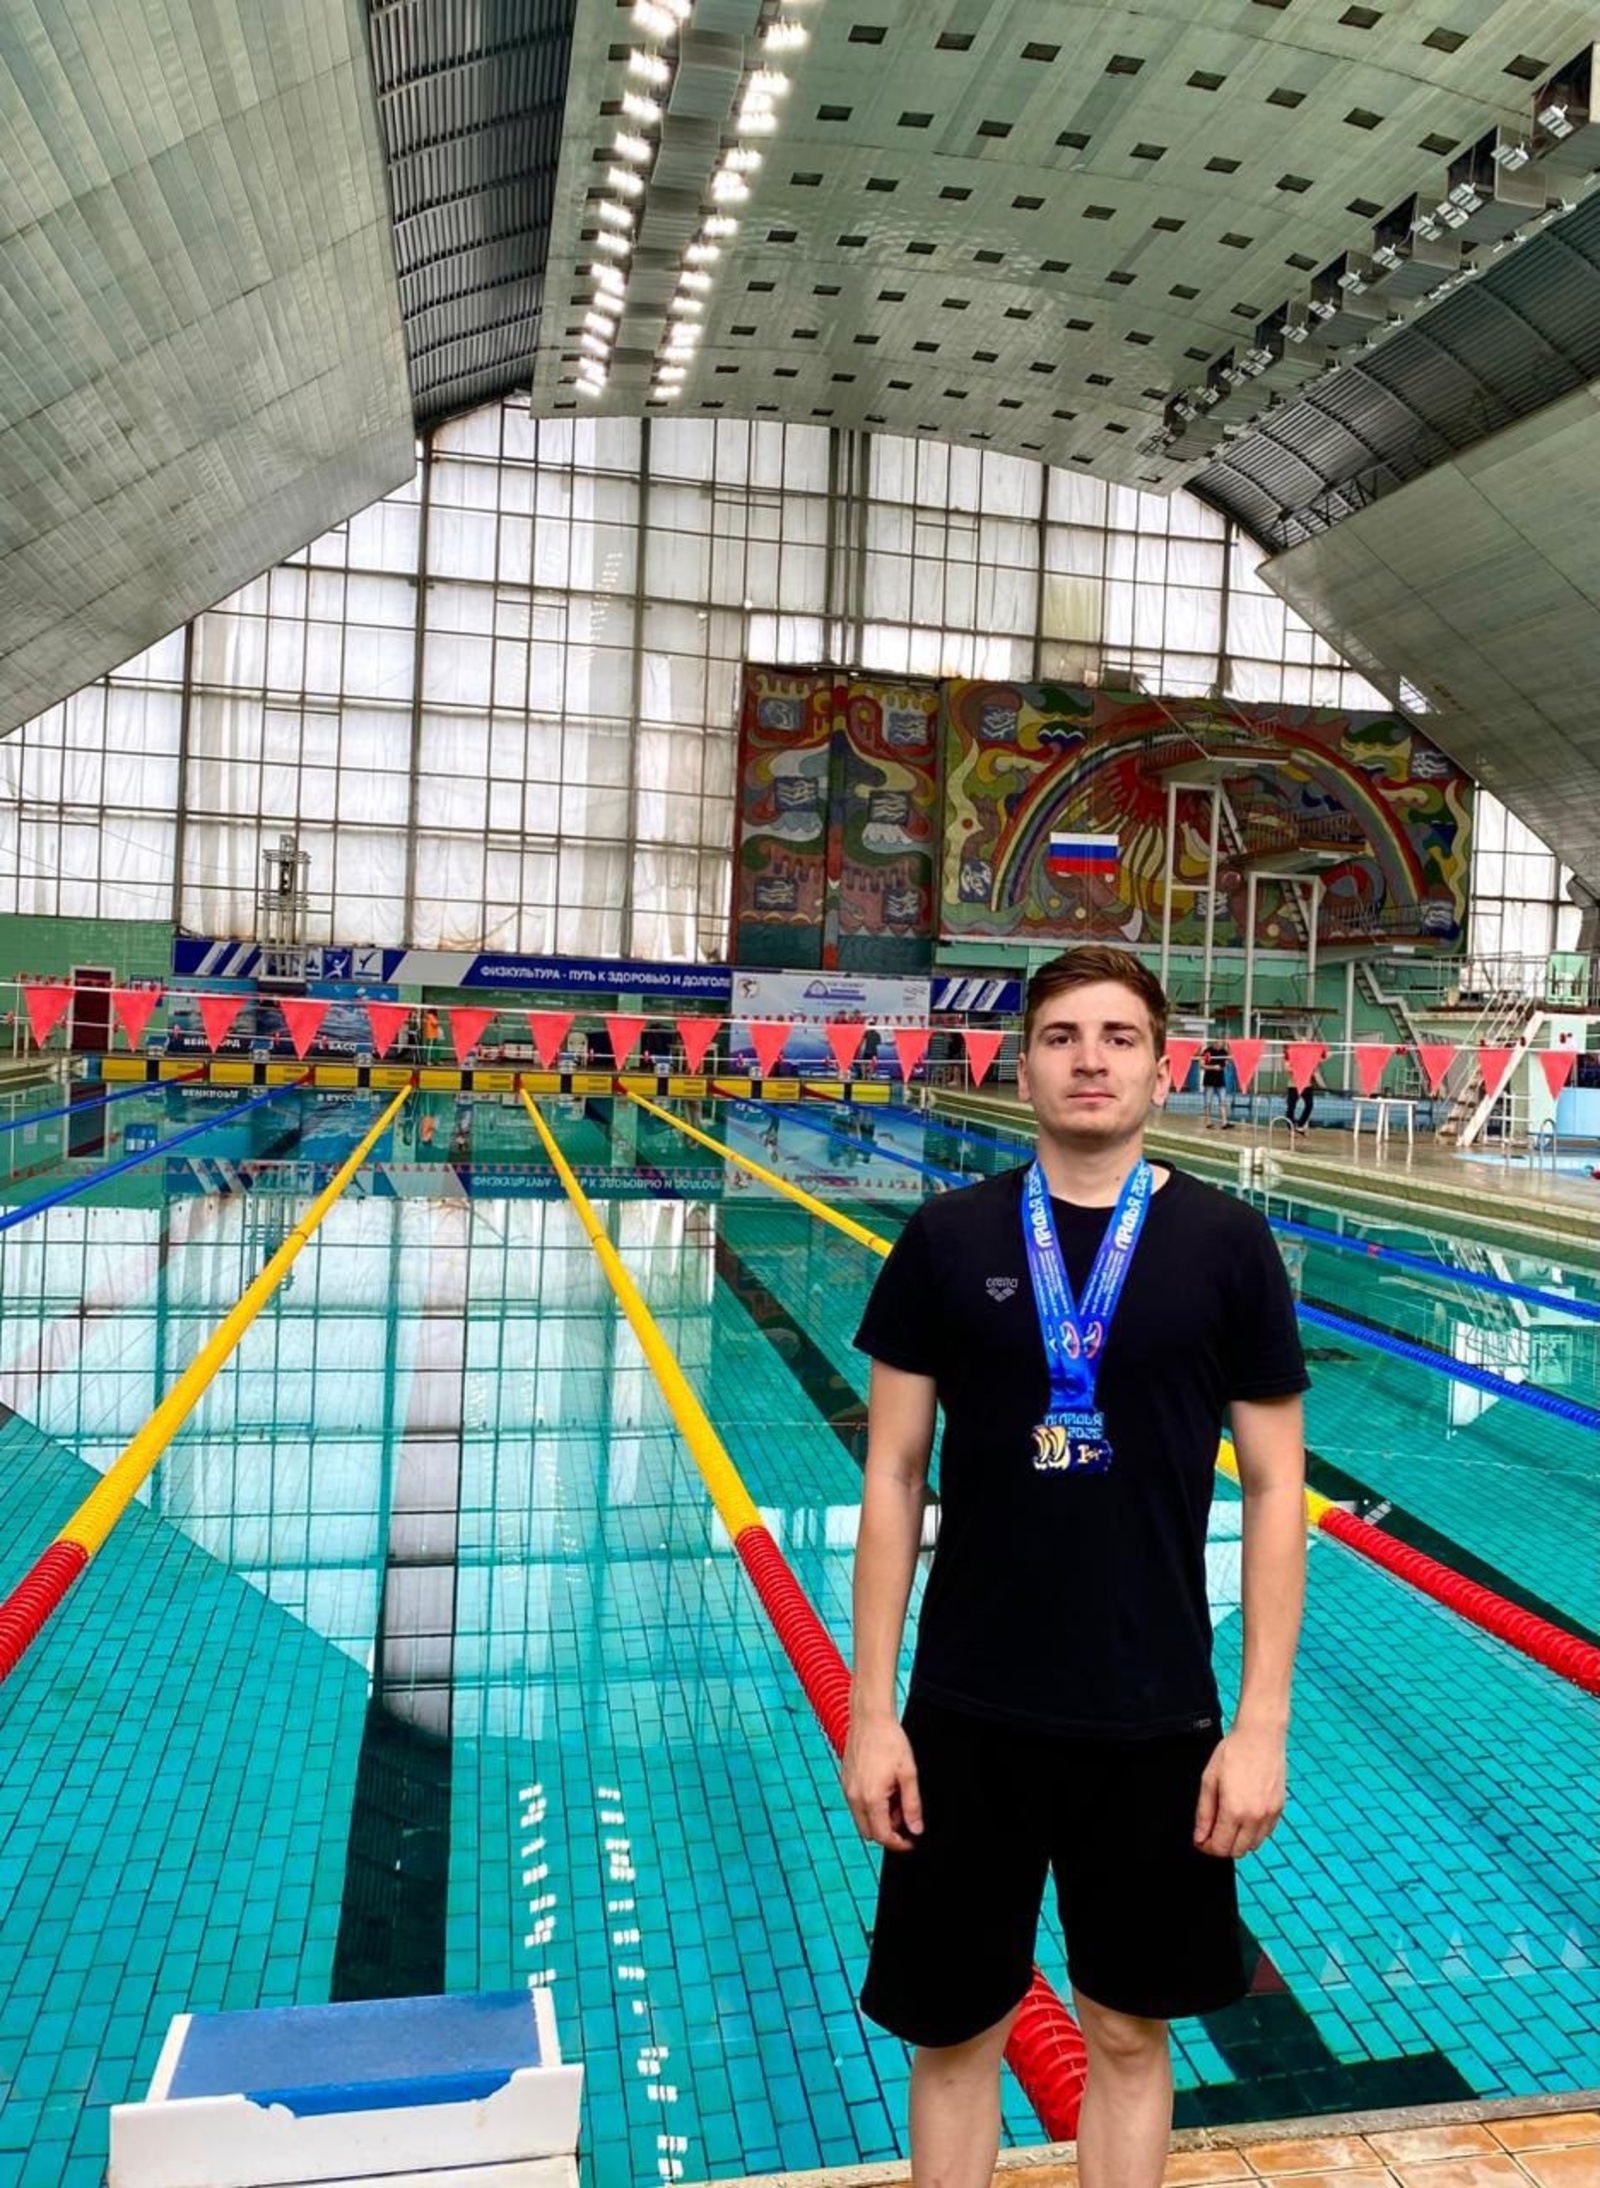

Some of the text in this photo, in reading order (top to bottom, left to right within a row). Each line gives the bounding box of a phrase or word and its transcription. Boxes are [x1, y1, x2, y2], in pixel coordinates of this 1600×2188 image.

[480, 965, 560, 980] ФИЗКУЛЬТУРА
[568, 969, 597, 982] ПУТЬ
[598, 970, 606, 981] К
[607, 971, 671, 985] ЗДОРОВЬЮ
[672, 974, 681, 985] И
[985, 1277, 1019, 1288] arena
